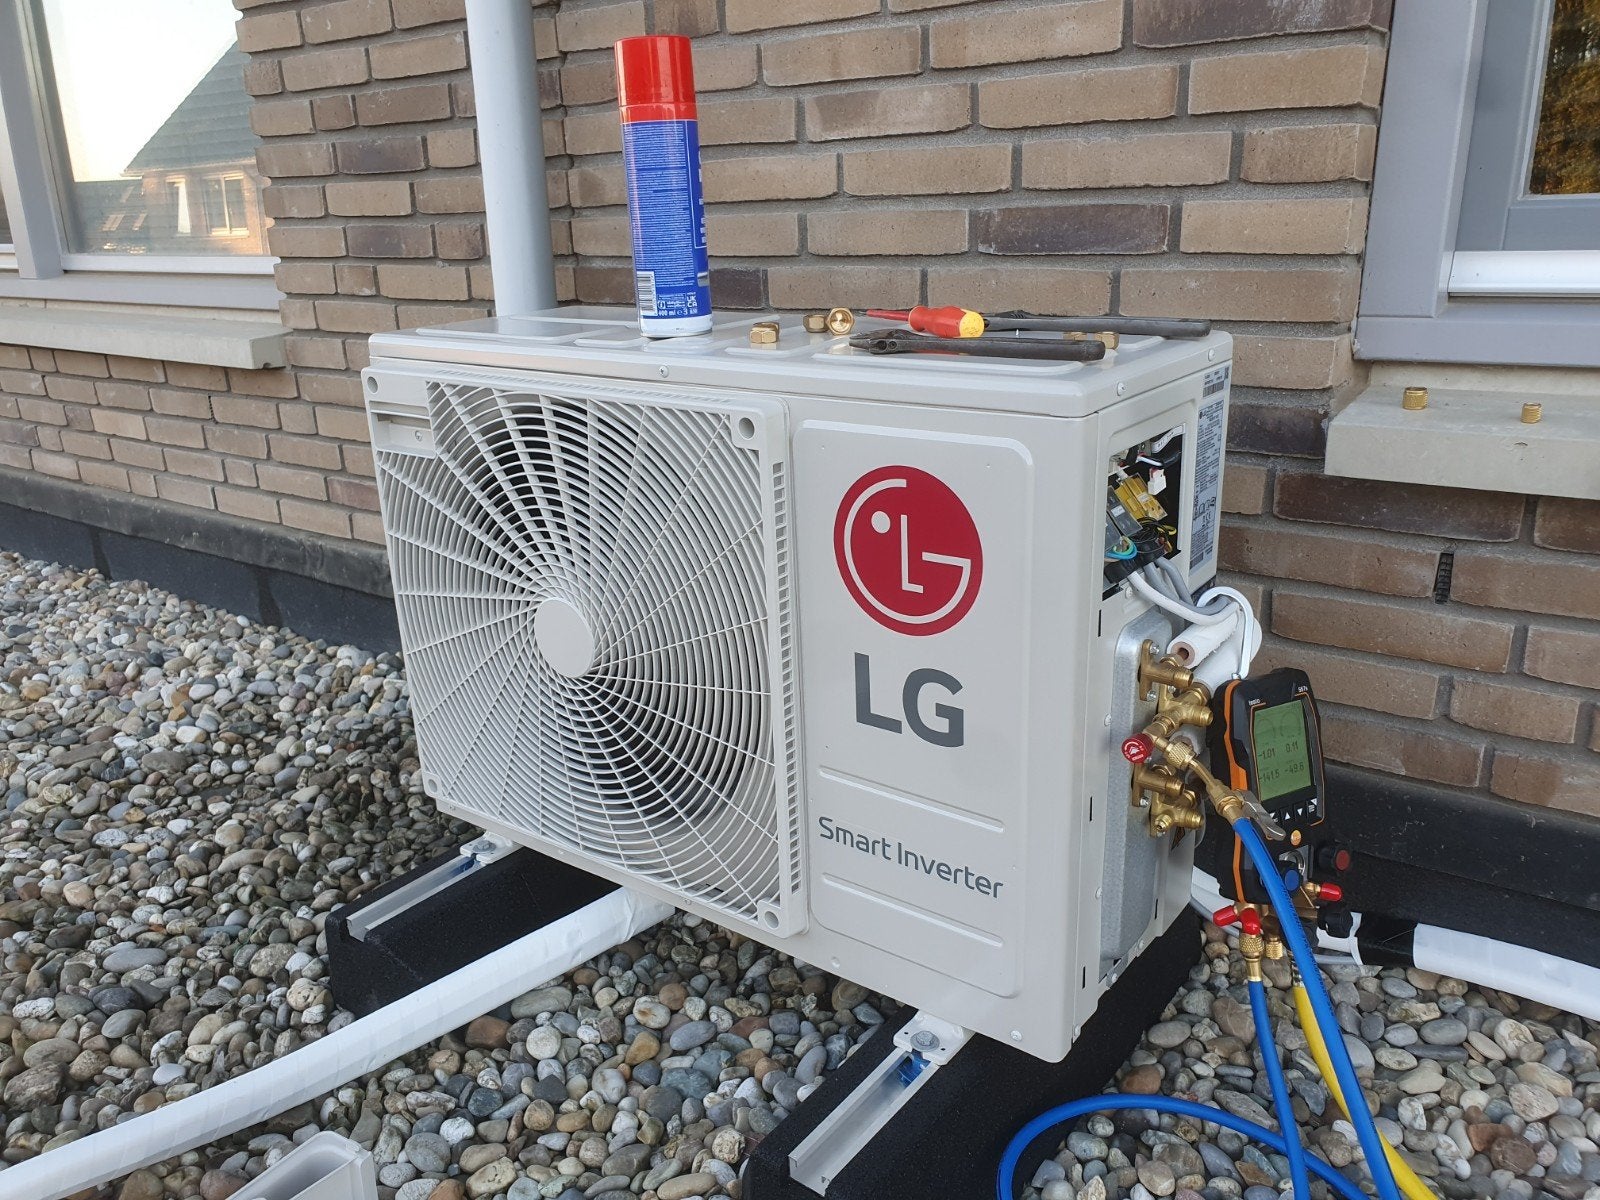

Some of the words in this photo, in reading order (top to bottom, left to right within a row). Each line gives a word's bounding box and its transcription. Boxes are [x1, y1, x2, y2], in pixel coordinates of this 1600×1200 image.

[843, 478, 972, 625] LG
[854, 652, 964, 748] LG
[818, 816, 892, 861] Smart
[897, 842, 1004, 899] Inverter
